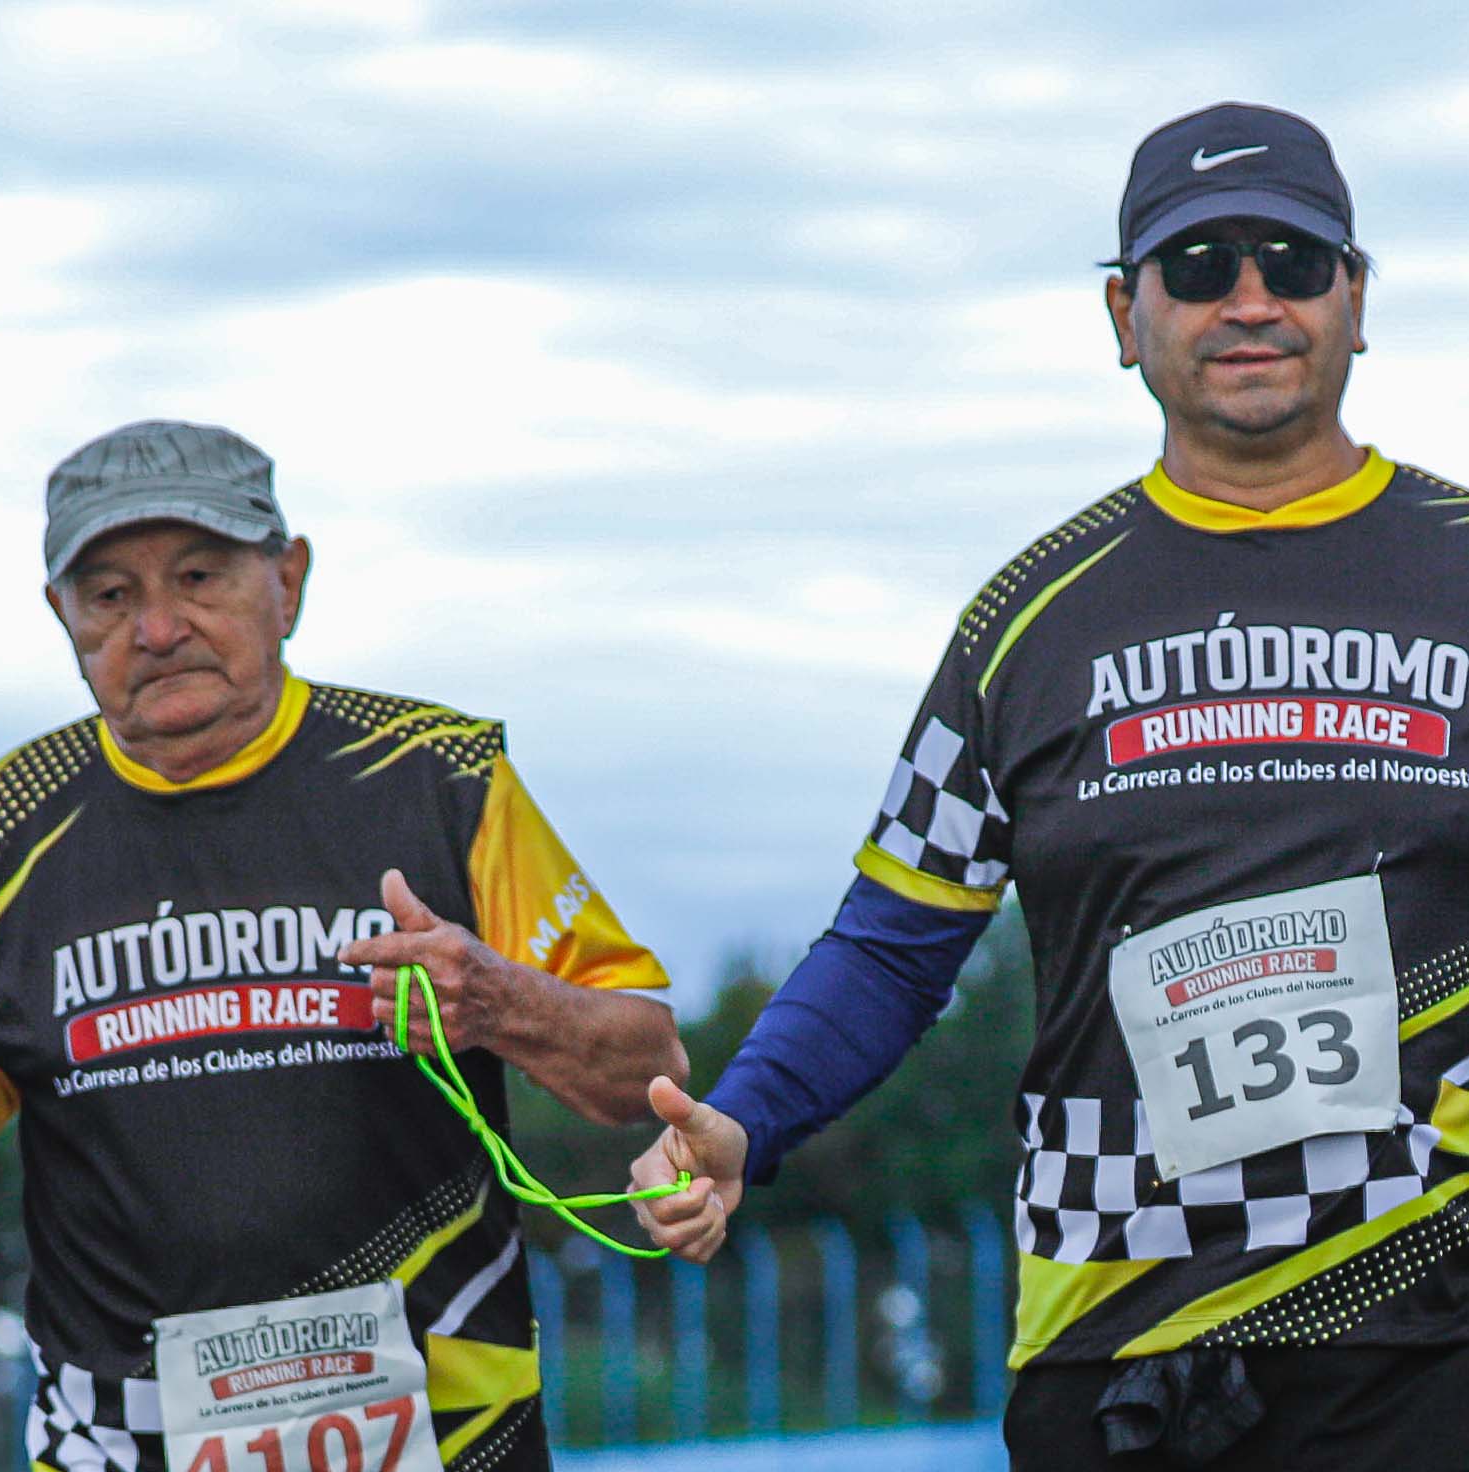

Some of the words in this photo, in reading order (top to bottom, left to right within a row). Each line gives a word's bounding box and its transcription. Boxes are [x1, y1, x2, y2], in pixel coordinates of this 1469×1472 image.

[1086, 612, 1469, 718] AUTÓDROMO
[1141, 701, 1303, 754] RUNNING
[1314, 703, 1411, 747] RACE
[1078, 780, 1099, 802] La
[1104, 768, 1181, 793] Carrera
[1187, 762, 1215, 784] de
[1220, 761, 1253, 783] los
[1259, 759, 1335, 782] Clubes
[1341, 759, 1377, 782] del
[1149, 909, 1346, 985] AUTÓDROMO
[1156, 1015, 1169, 1026] La
[1170, 1003, 1210, 1023] Carrera
[1212, 998, 1226, 1010] de
[1228, 993, 1245, 1005] los
[1246, 985, 1284, 1001] Clubes
[1287, 981, 1304, 993] del
[1306, 976, 1354, 991] Noroeste
[1183, 957, 1263, 998] RUNNING
[1267, 951, 1316, 974] RACE
[96, 990, 241, 1051] RUNNING
[250, 988, 340, 1026] RACE
[72, 1066, 139, 1093] Carrera
[143, 1057, 169, 1082] de
[171, 1054, 202, 1077] los
[204, 1048, 275, 1074] Clubes
[278, 1042, 313, 1069] del
[1174, 1009, 1361, 1121] 133
[195, 1314, 379, 1376] AUTÓDROMO
[228, 1364, 307, 1393] RUNNING
[311, 1355, 357, 1376] RACE
